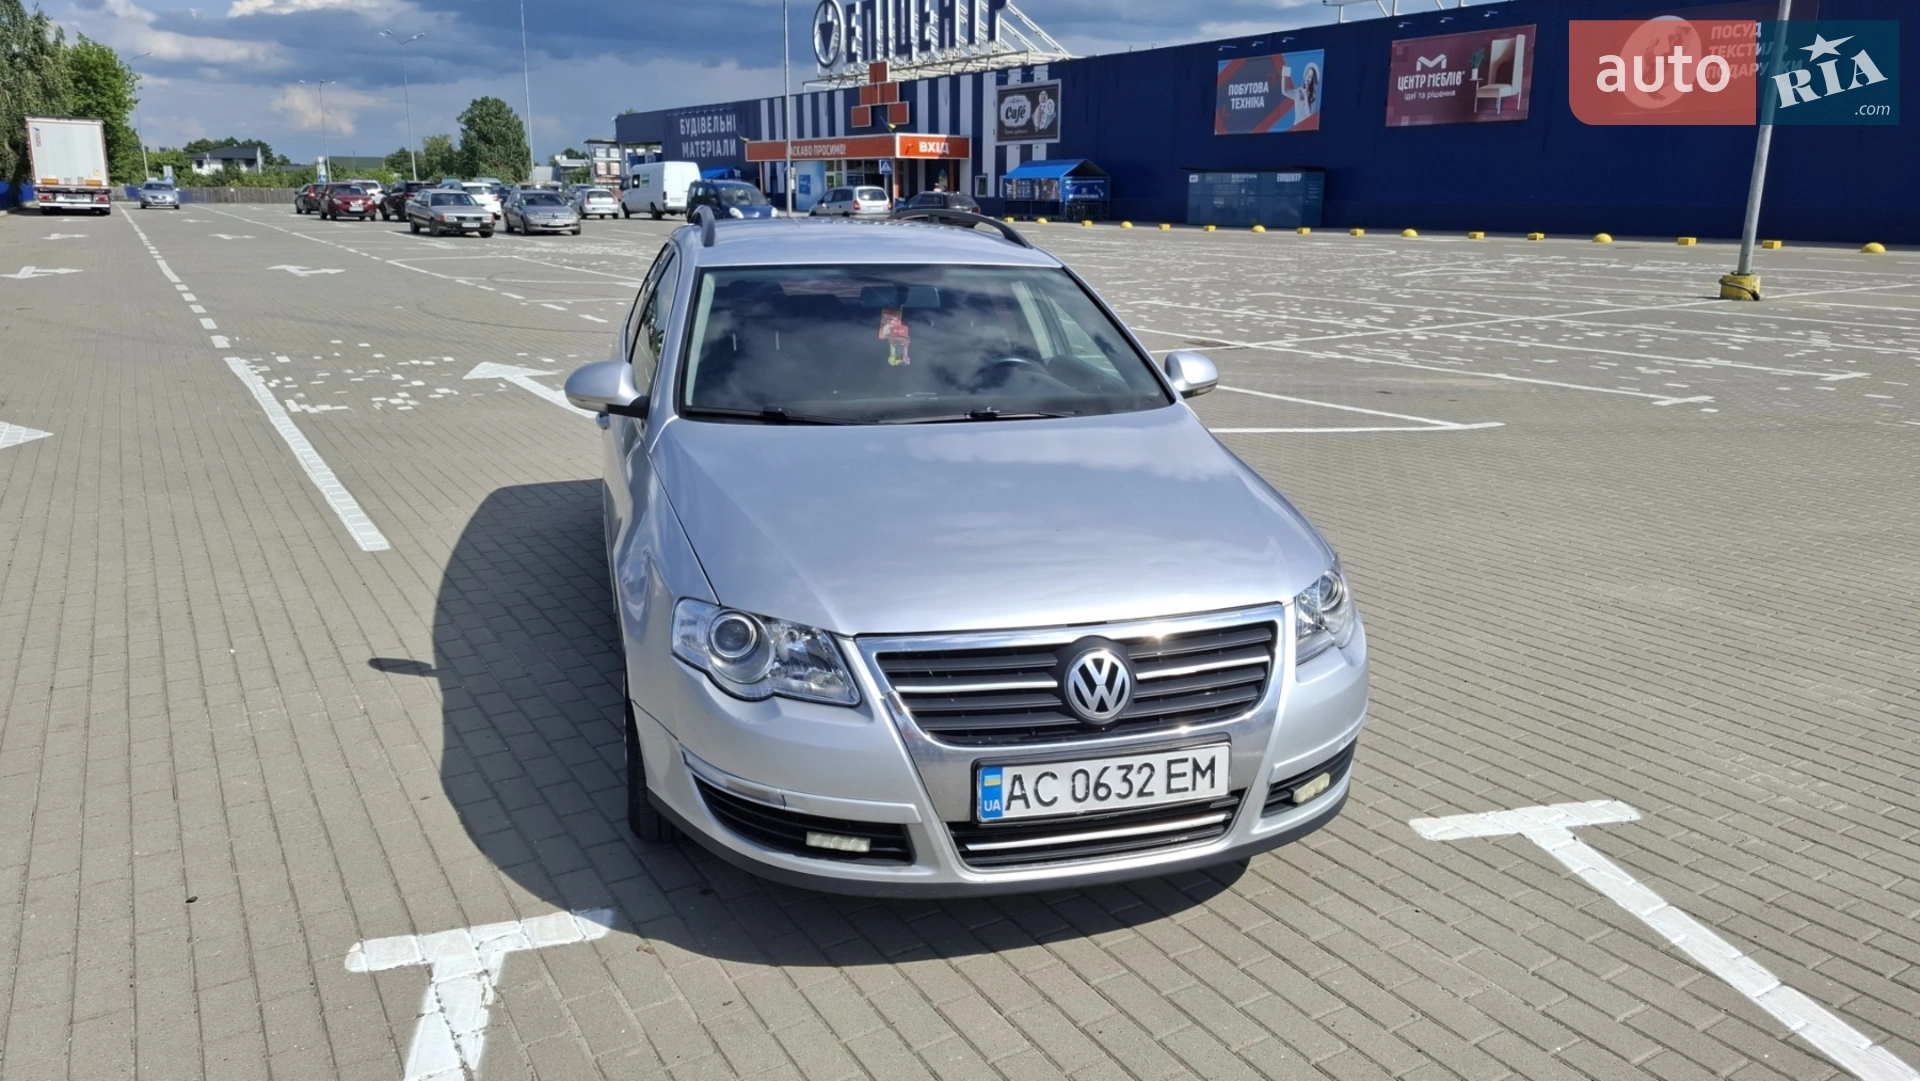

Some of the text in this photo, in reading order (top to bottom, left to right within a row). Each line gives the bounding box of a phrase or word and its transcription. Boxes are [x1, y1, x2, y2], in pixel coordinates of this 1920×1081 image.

[1711, 22, 1762, 40] ПОСУД
[1706, 59, 1803, 80] ПОДАРУКИ
[1228, 81, 1270, 96] ПОБУТОВА
[1397, 70, 1462, 91] ЦЕНТР МЕБЛІВ
[1230, 96, 1265, 110] ТЕХНІКА
[1418, 91, 1426, 100] та
[1426, 90, 1456, 100] рішення
[1005, 105, 1026, 123] Café
[680, 114, 736, 138] БУДІВЕЛЬНІ
[682, 138, 737, 158] МАТЕРІАЛИ
[918, 141, 950, 155] ВХІД
[1004, 753, 1217, 812] AC 0632 EM
[983, 798, 1001, 812] UA
